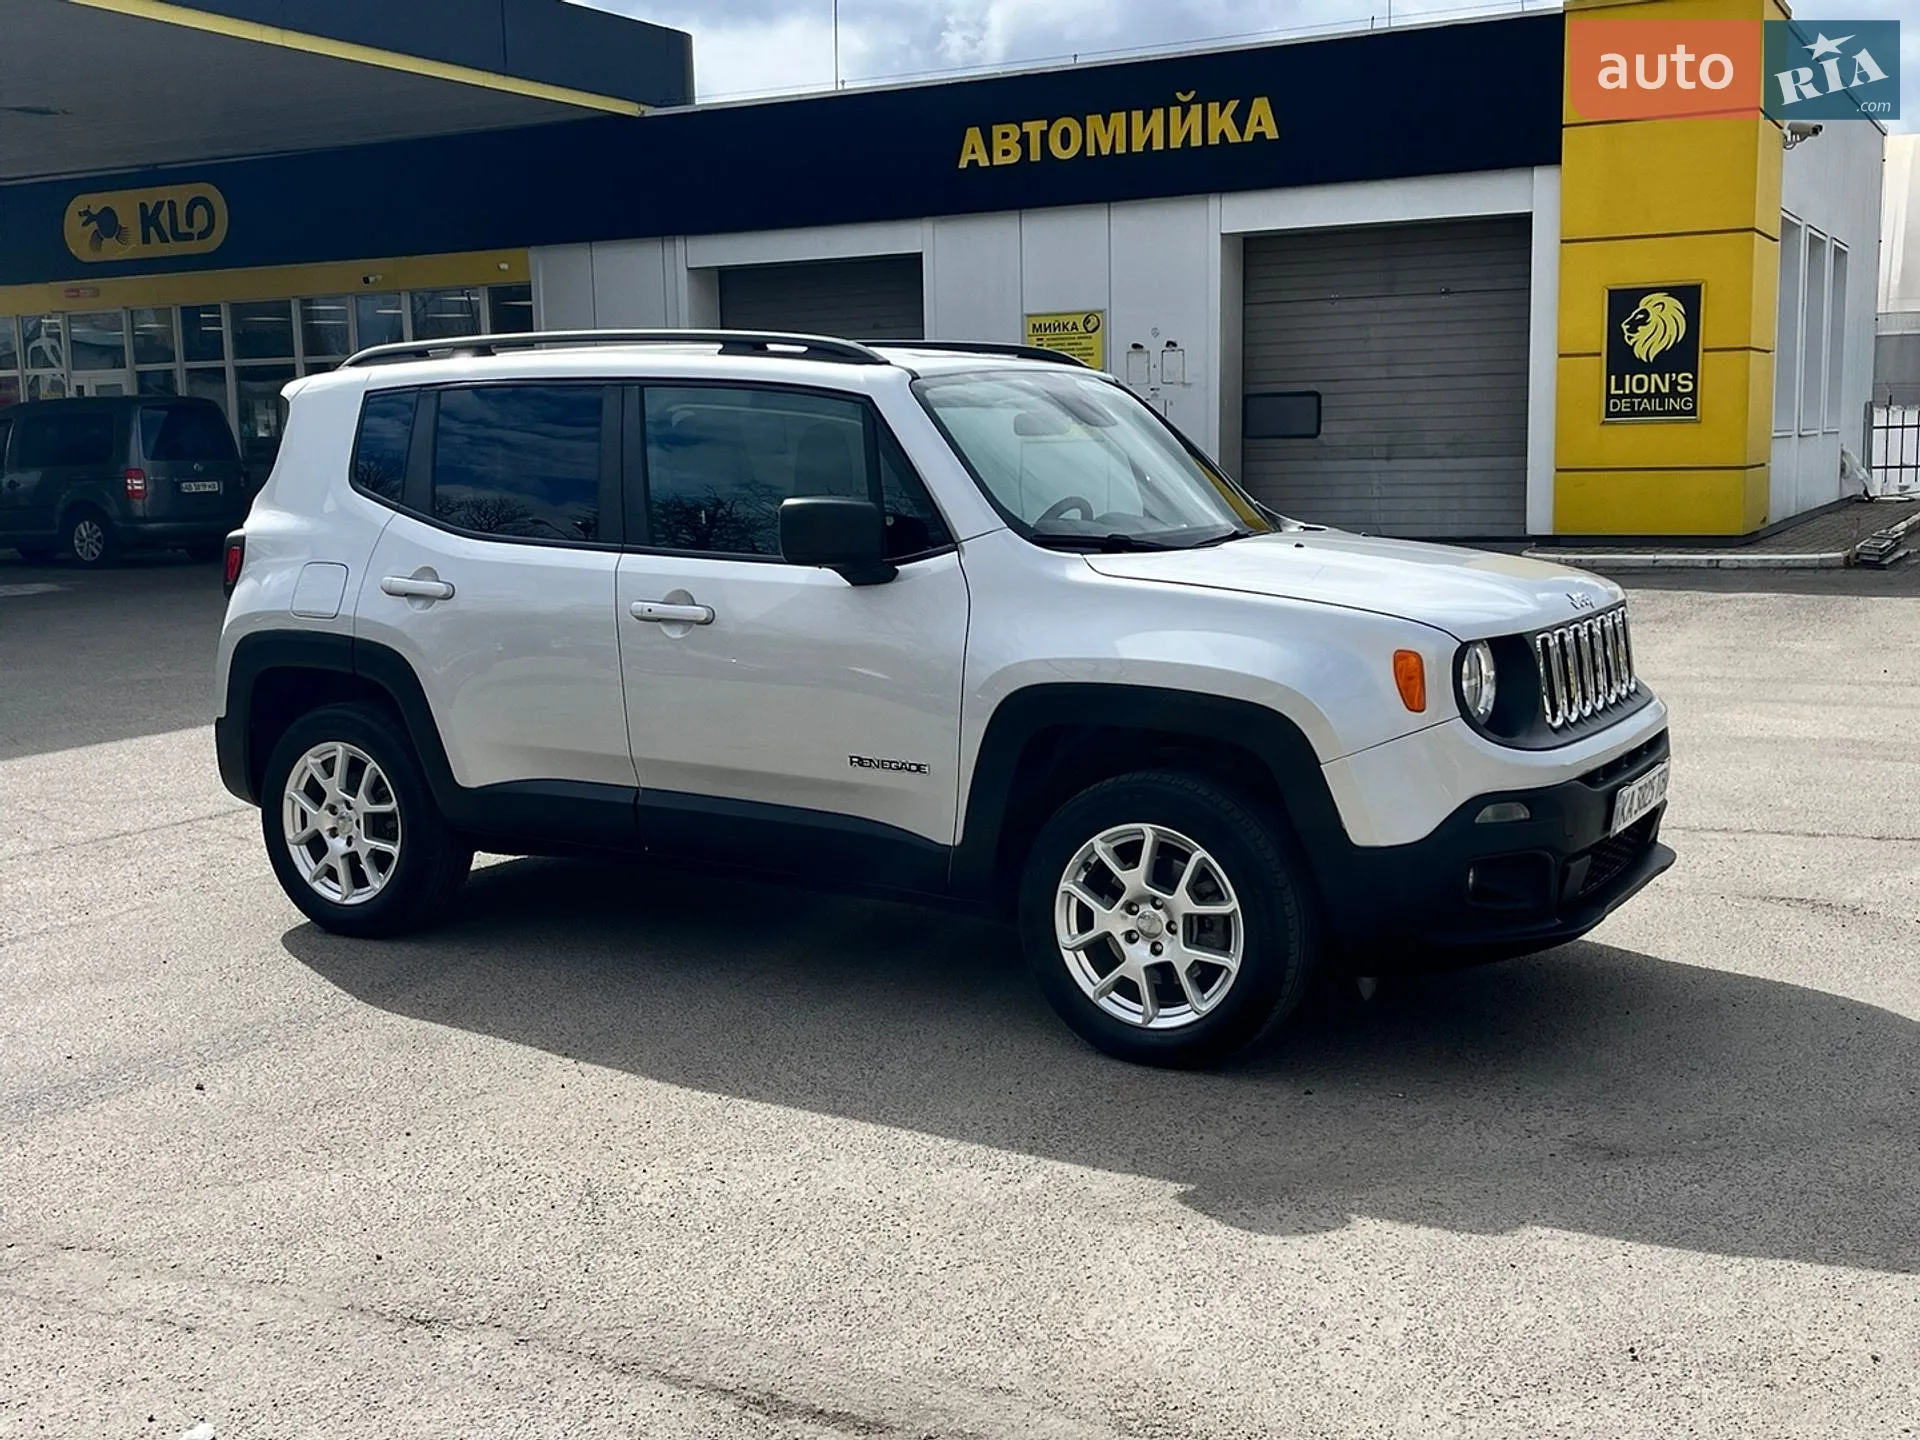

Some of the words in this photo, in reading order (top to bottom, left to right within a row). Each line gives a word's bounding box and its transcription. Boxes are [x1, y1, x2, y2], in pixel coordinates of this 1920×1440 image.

[958, 90, 1279, 169] АВТОМИЙКА
[139, 195, 216, 245] KLO
[1032, 320, 1079, 334] МИЙКА
[1610, 372, 1694, 395] LION'S
[1609, 396, 1694, 412] DETAILING
